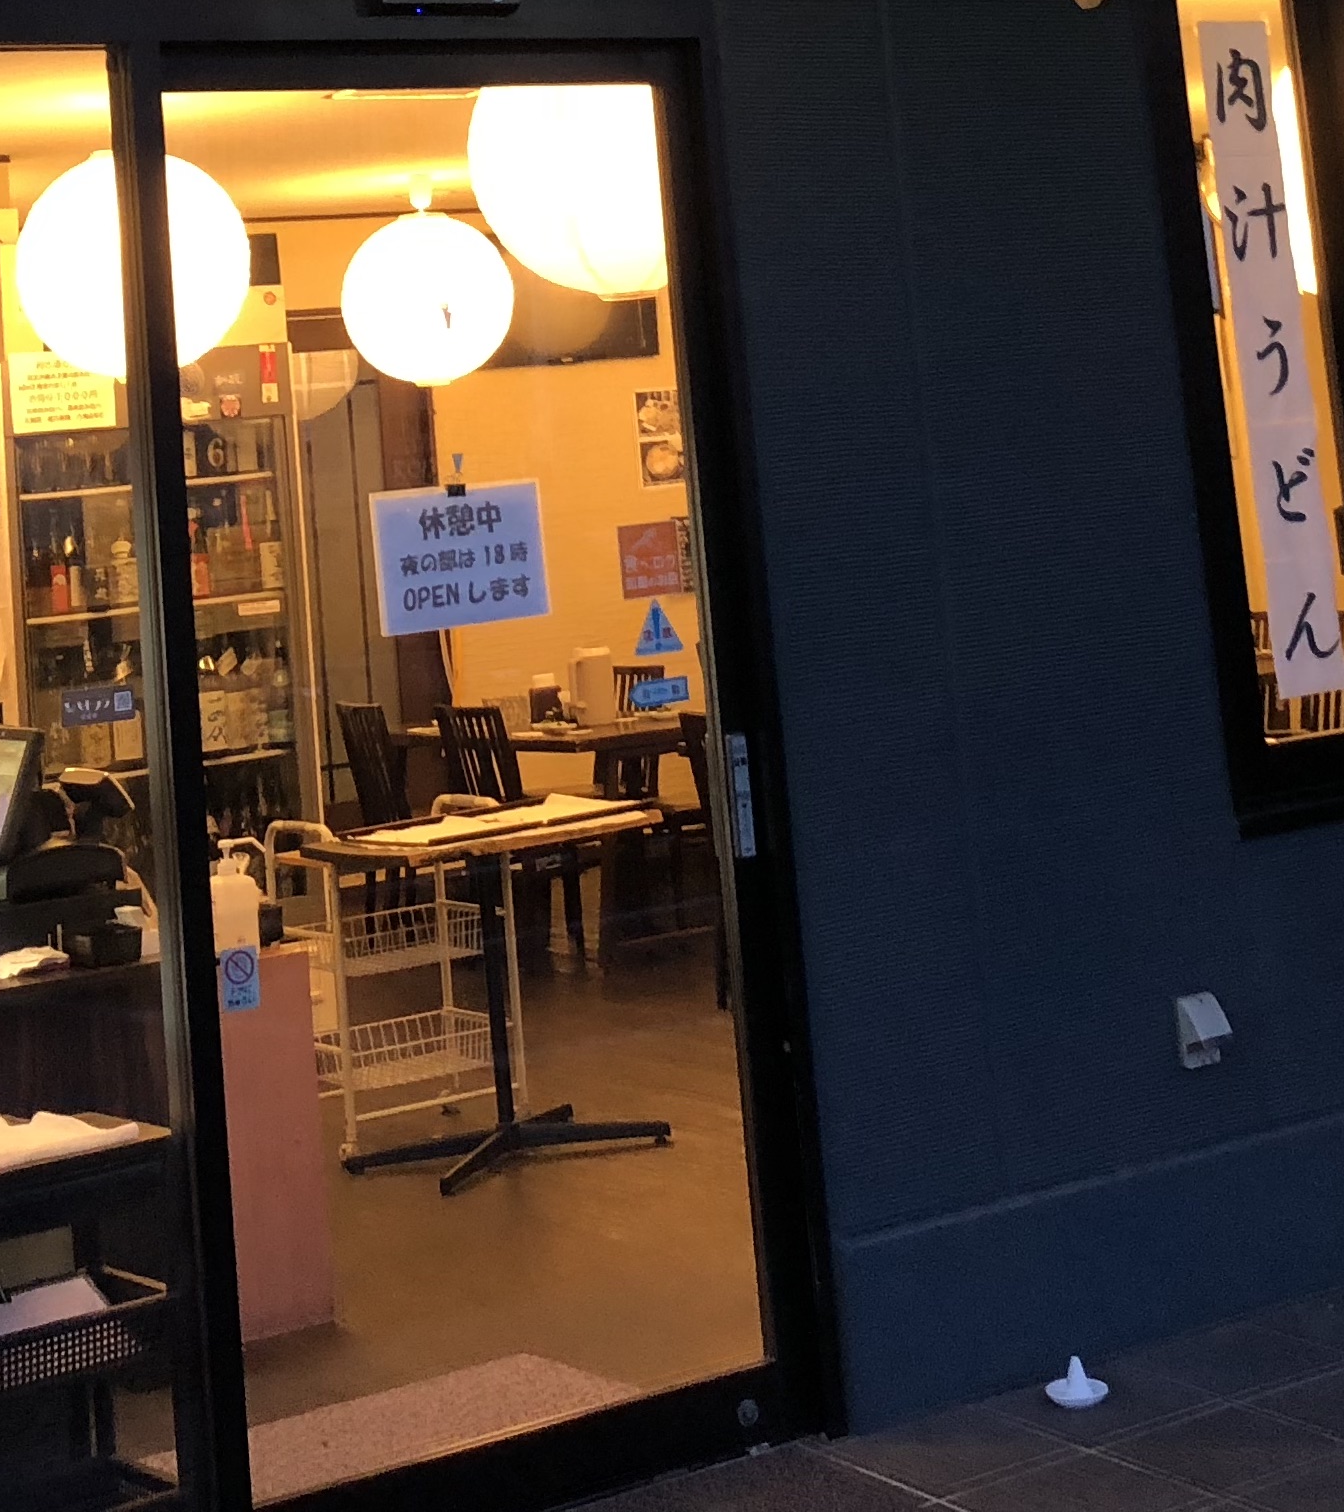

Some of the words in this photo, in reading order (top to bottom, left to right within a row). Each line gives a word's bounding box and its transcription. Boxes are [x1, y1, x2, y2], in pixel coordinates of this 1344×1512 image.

[1215, 46, 1338, 663] 肉汁うどん
[418, 500, 503, 541] 休憩中
